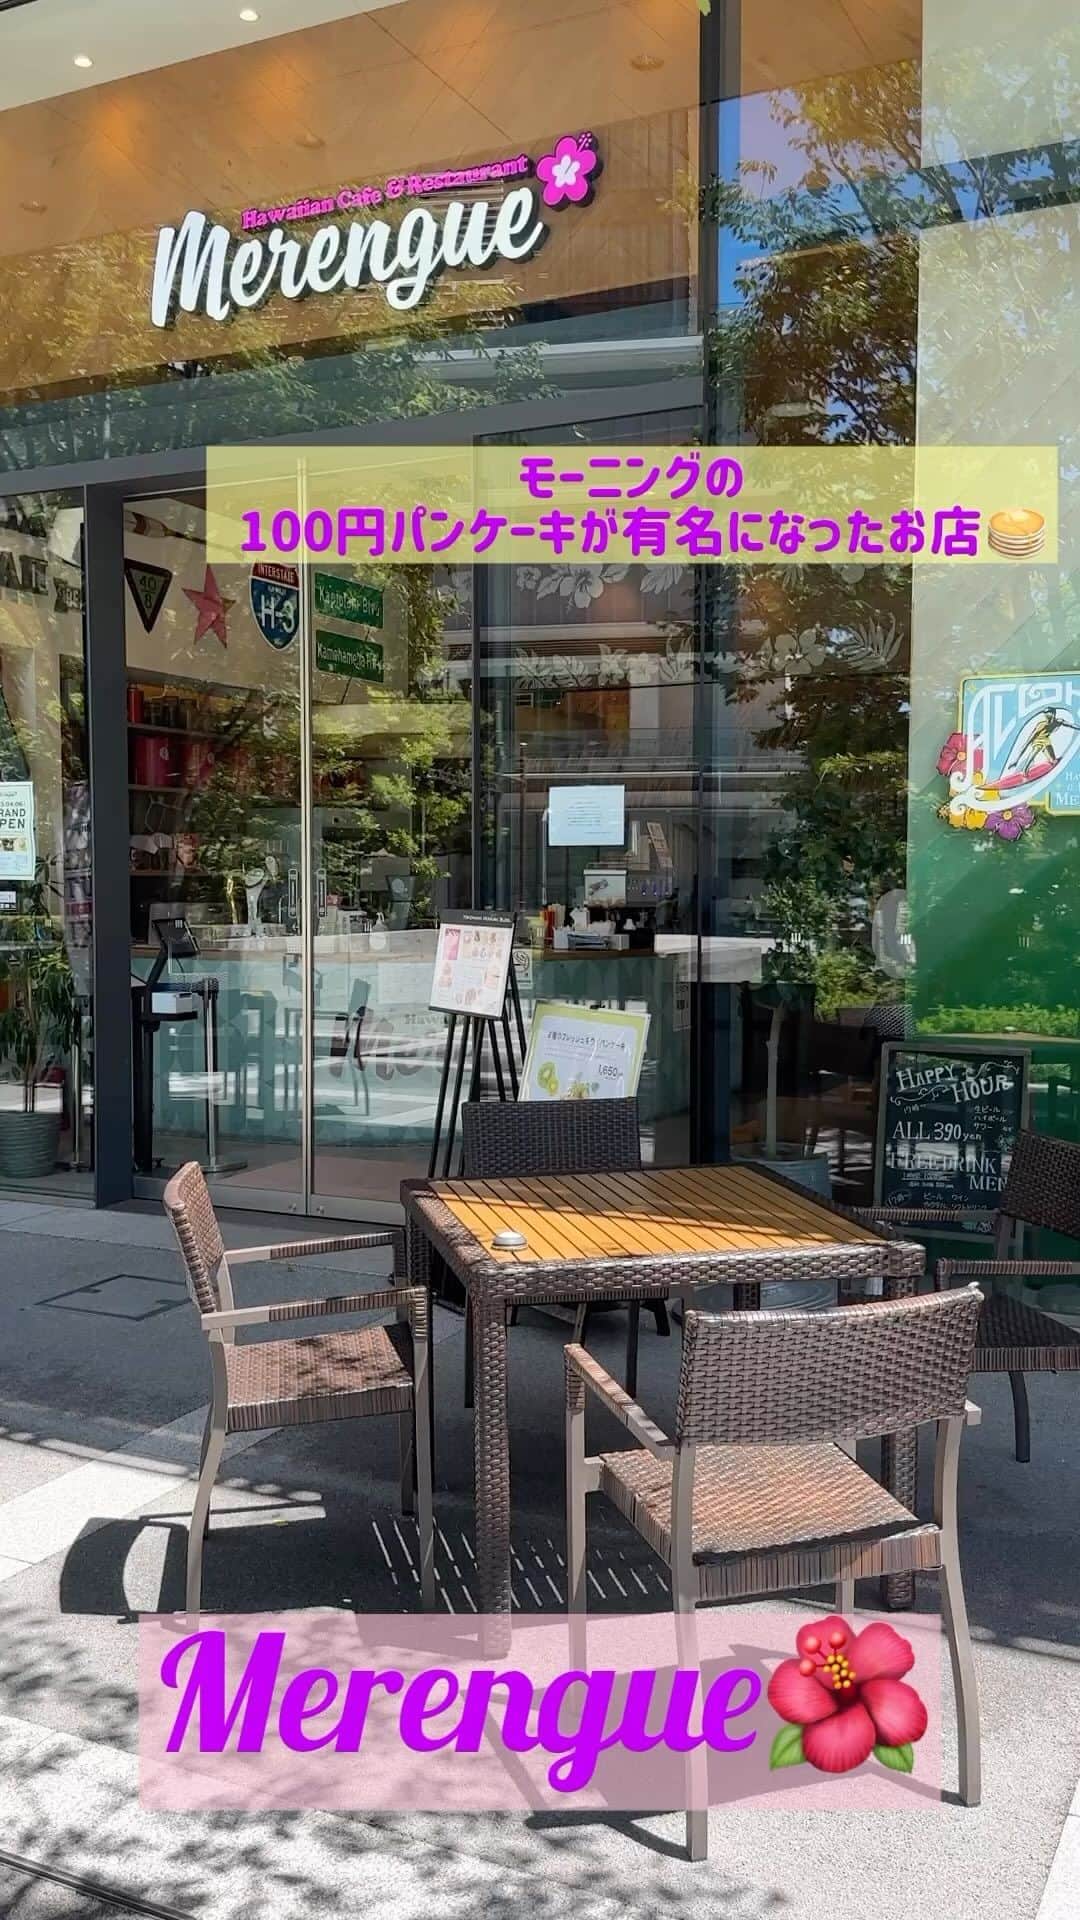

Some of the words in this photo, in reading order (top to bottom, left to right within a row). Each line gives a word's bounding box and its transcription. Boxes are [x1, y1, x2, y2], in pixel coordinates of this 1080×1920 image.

[241, 194, 335, 231] Hawaiian
[337, 184, 383, 213] Cafe
[385, 175, 409, 199] &
[405, 153, 529, 197] Restaurant
[151, 187, 544, 328] Merengue
[257, 563, 296, 583] INTERSTATE
[259, 594, 297, 634] H-3
[895, 1063, 955, 1093] HAPPY
[950, 1074, 1014, 1104] HOUR
[892, 1120, 931, 1140] ALL
[933, 1121, 962, 1141] 390
[968, 1174, 1009, 1192] MEN
